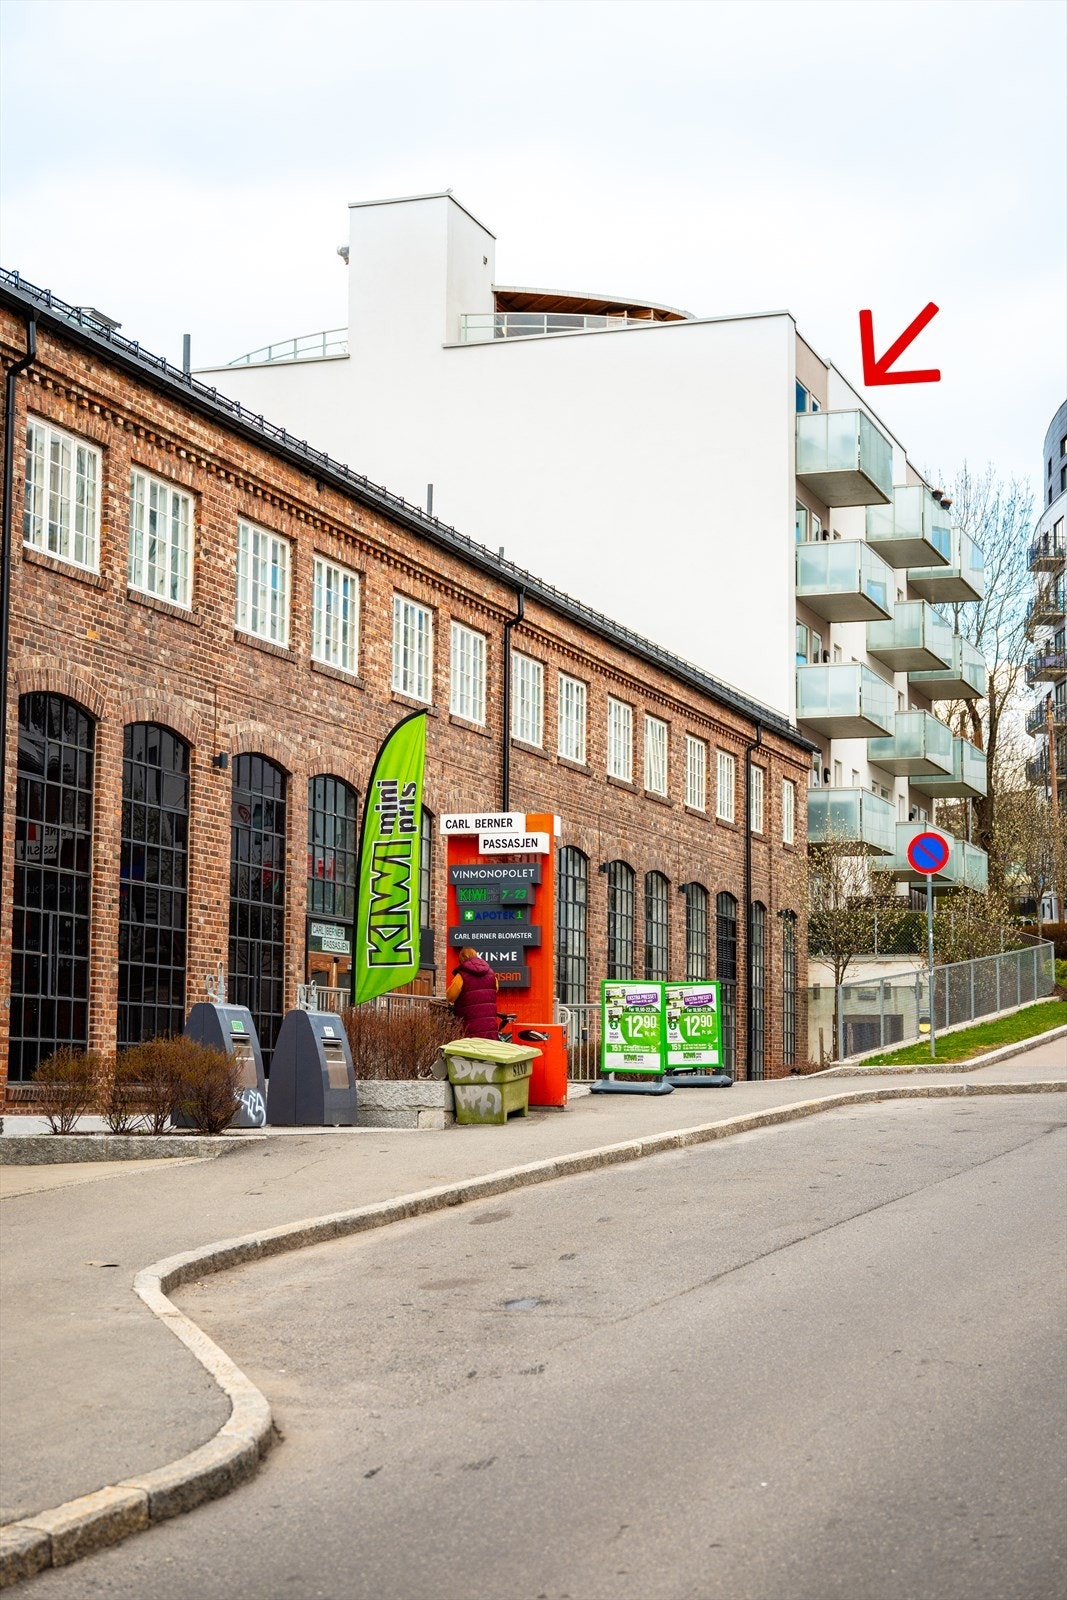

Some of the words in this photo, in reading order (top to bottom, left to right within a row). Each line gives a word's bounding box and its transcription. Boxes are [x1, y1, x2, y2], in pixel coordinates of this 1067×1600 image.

[375, 779, 398, 835] mini
[397, 781, 417, 834] pris
[445, 819, 471, 830] CARL
[475, 817, 513, 829] BERNER
[483, 837, 538, 849] PASSASJEN
[452, 868, 535, 880] VINMONOPOLET
[458, 887, 487, 902] KIWI
[367, 840, 414, 968] KIWI
[475, 910, 515, 921] APOTEK
[516, 910, 523, 919] 1
[312, 924, 325, 935] CARL
[326, 925, 344, 938] BERNER
[471, 932, 497, 940] BERNER
[497, 932, 532, 940] BLOMSTER
[323, 939, 349, 951] PASSASJEN
[476, 951, 517, 961] KINME
